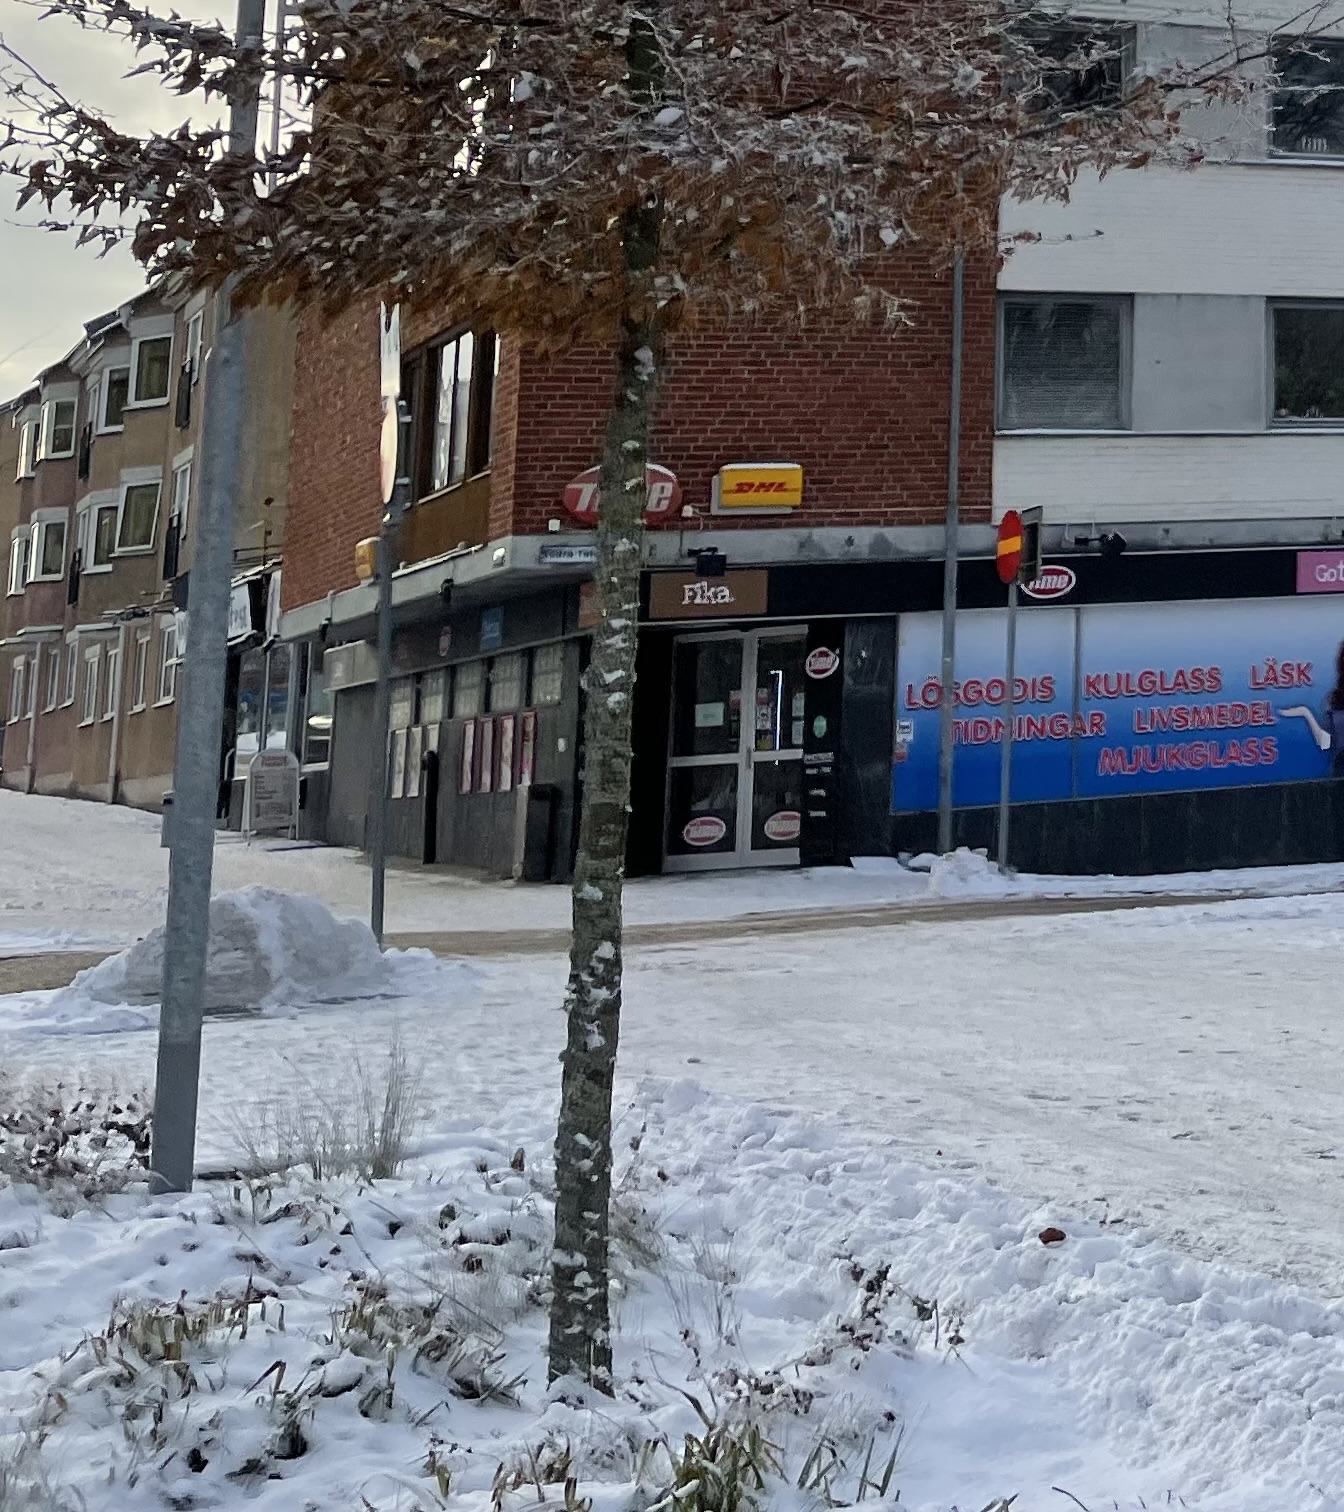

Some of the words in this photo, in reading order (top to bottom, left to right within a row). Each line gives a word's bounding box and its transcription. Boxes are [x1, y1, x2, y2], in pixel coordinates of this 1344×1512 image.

[735, 482, 789, 493] DHL
[682, 581, 733, 605] Fika
[1084, 665, 1222, 698] KULGLASS
[952, 710, 1106, 746] TIDNINGAR
[1134, 700, 1278, 735] LIVSMEDEL
[1098, 737, 1279, 777] MJUKGLASS
